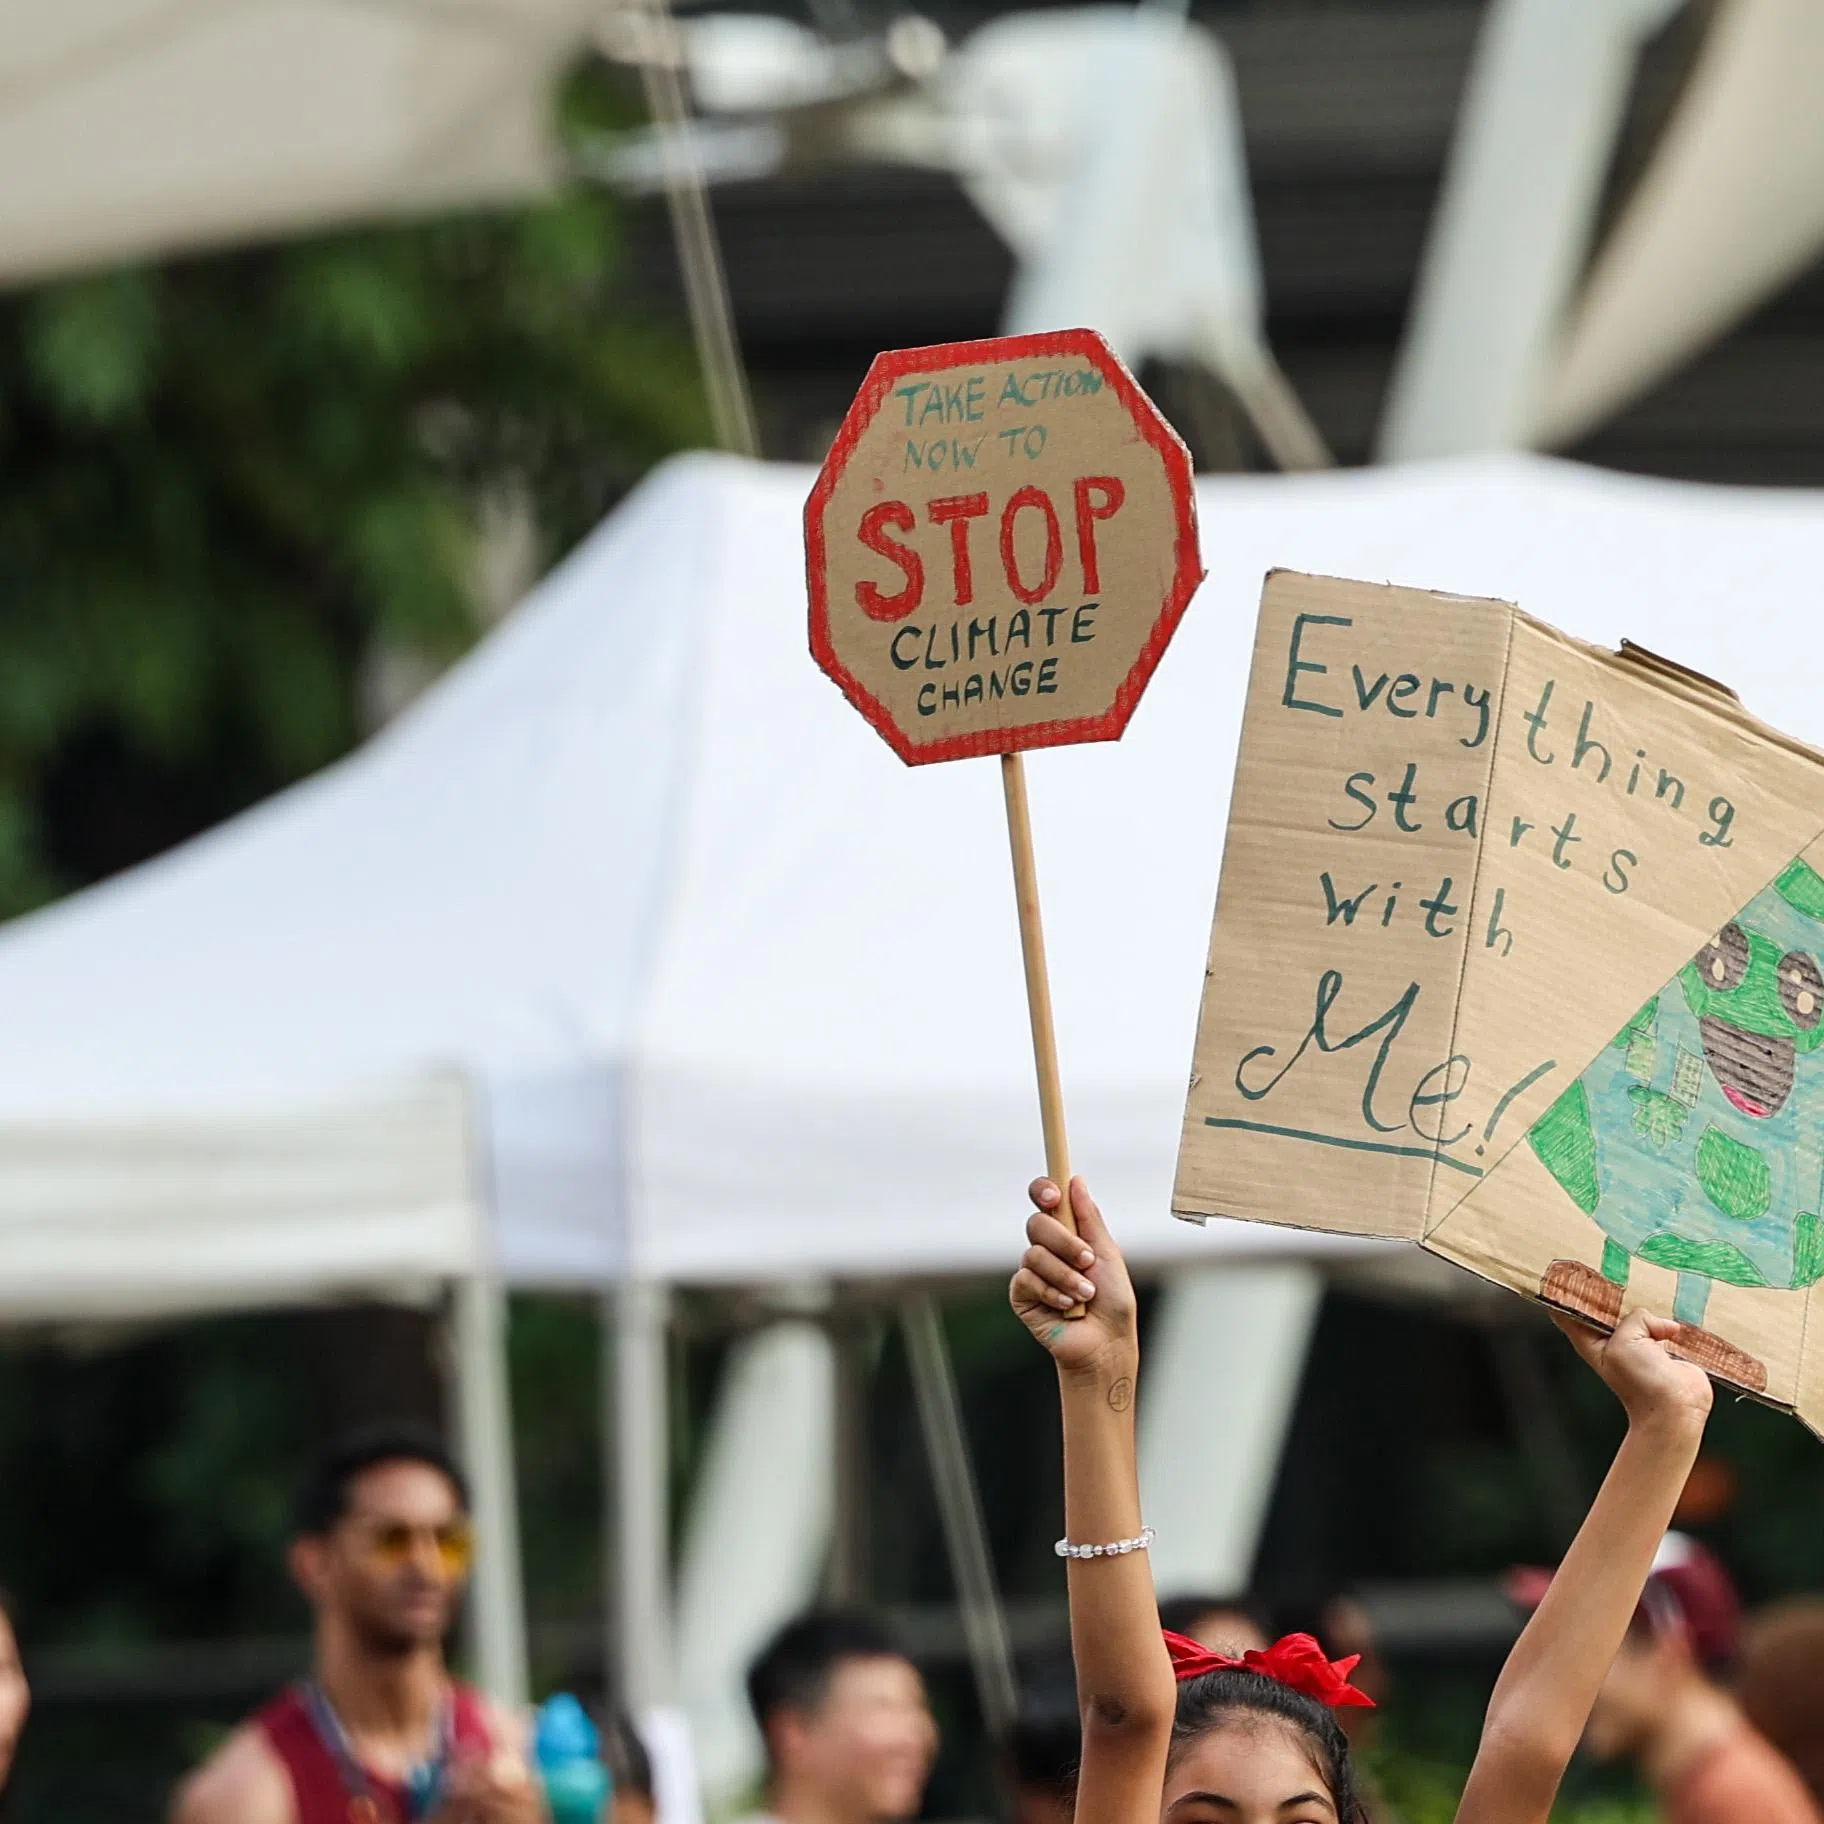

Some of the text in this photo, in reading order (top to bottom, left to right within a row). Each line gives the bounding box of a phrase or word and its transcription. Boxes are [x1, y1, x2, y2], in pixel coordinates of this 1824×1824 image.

[895, 368, 1105, 428] TAKE ACTION
[902, 424, 1048, 474] NOW TO
[855, 475, 1126, 623] STOP
[890, 603, 1101, 671] CLIMATE
[916, 657, 1060, 716] CHANGE
[1235, 970, 1558, 1157] Me!
